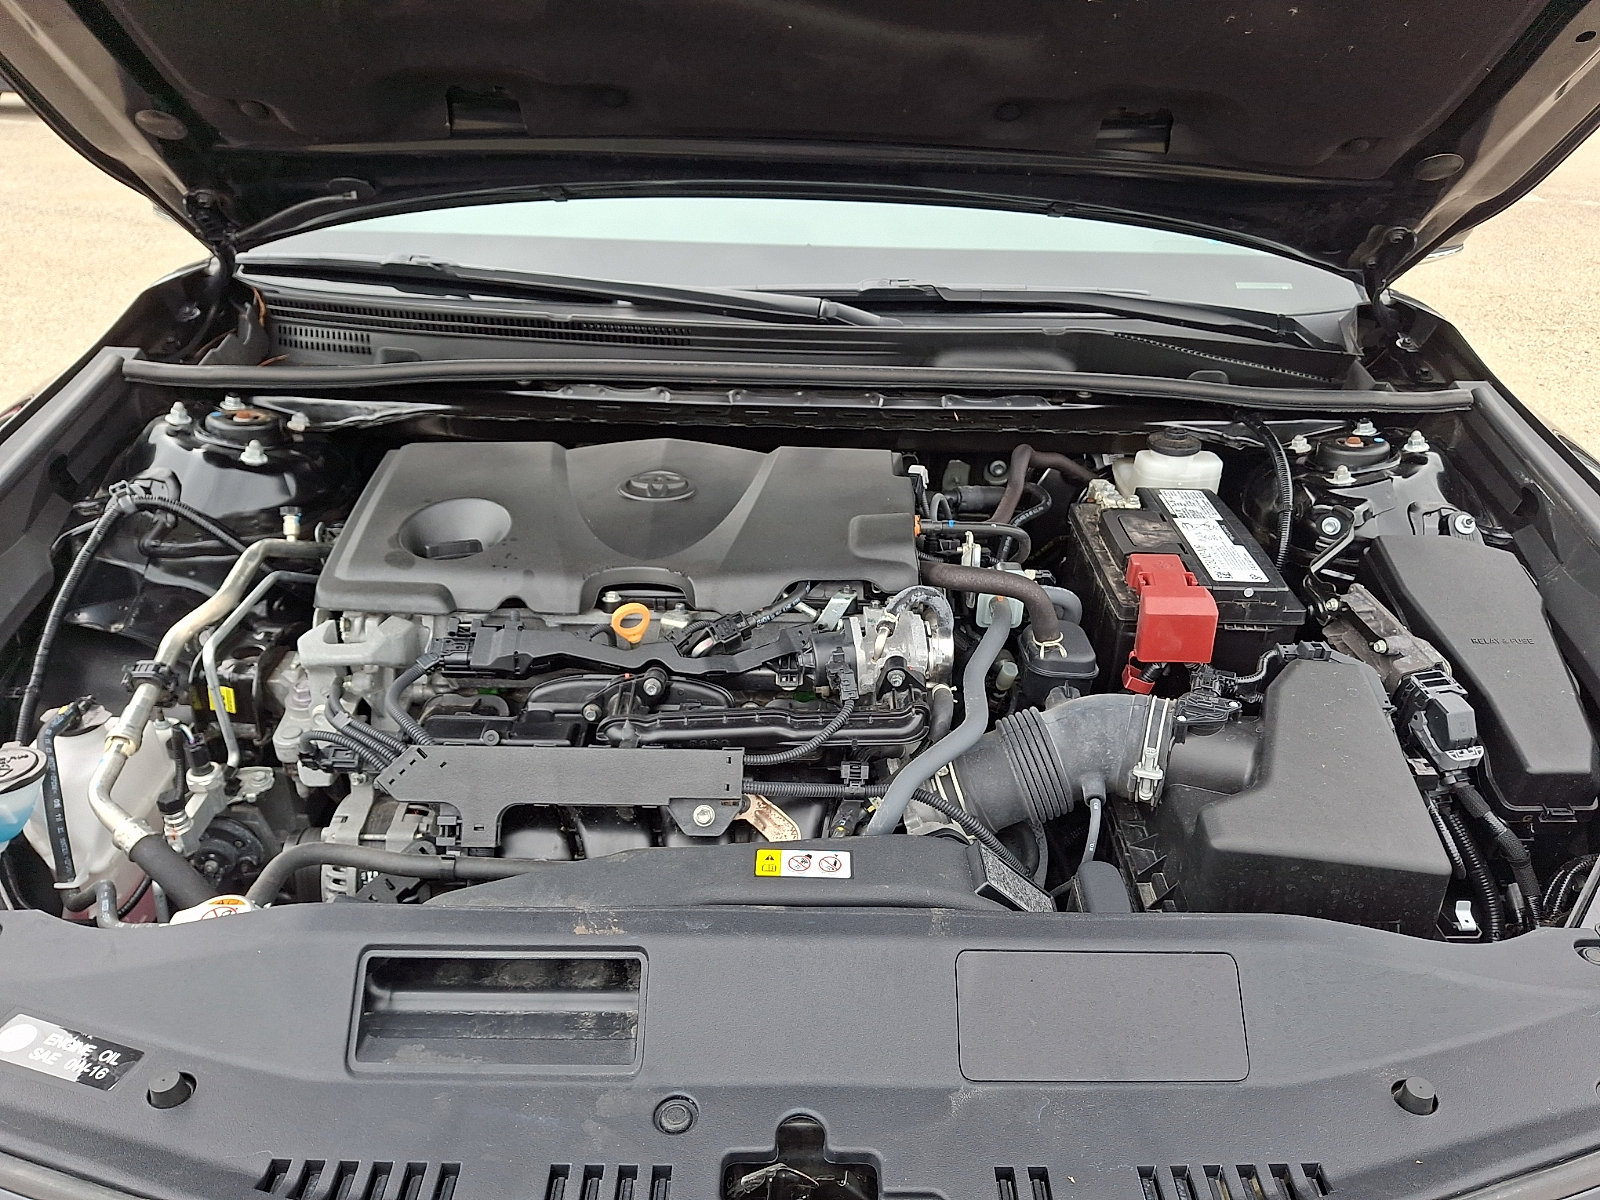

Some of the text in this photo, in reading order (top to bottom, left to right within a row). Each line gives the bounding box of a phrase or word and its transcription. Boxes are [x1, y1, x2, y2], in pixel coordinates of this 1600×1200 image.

[1470, 637, 1500, 645] RELAY
[1511, 637, 1535, 645] FUSE
[28, 1047, 62, 1066] SAE
[43, 1033, 121, 1066] ENGINE OIL
